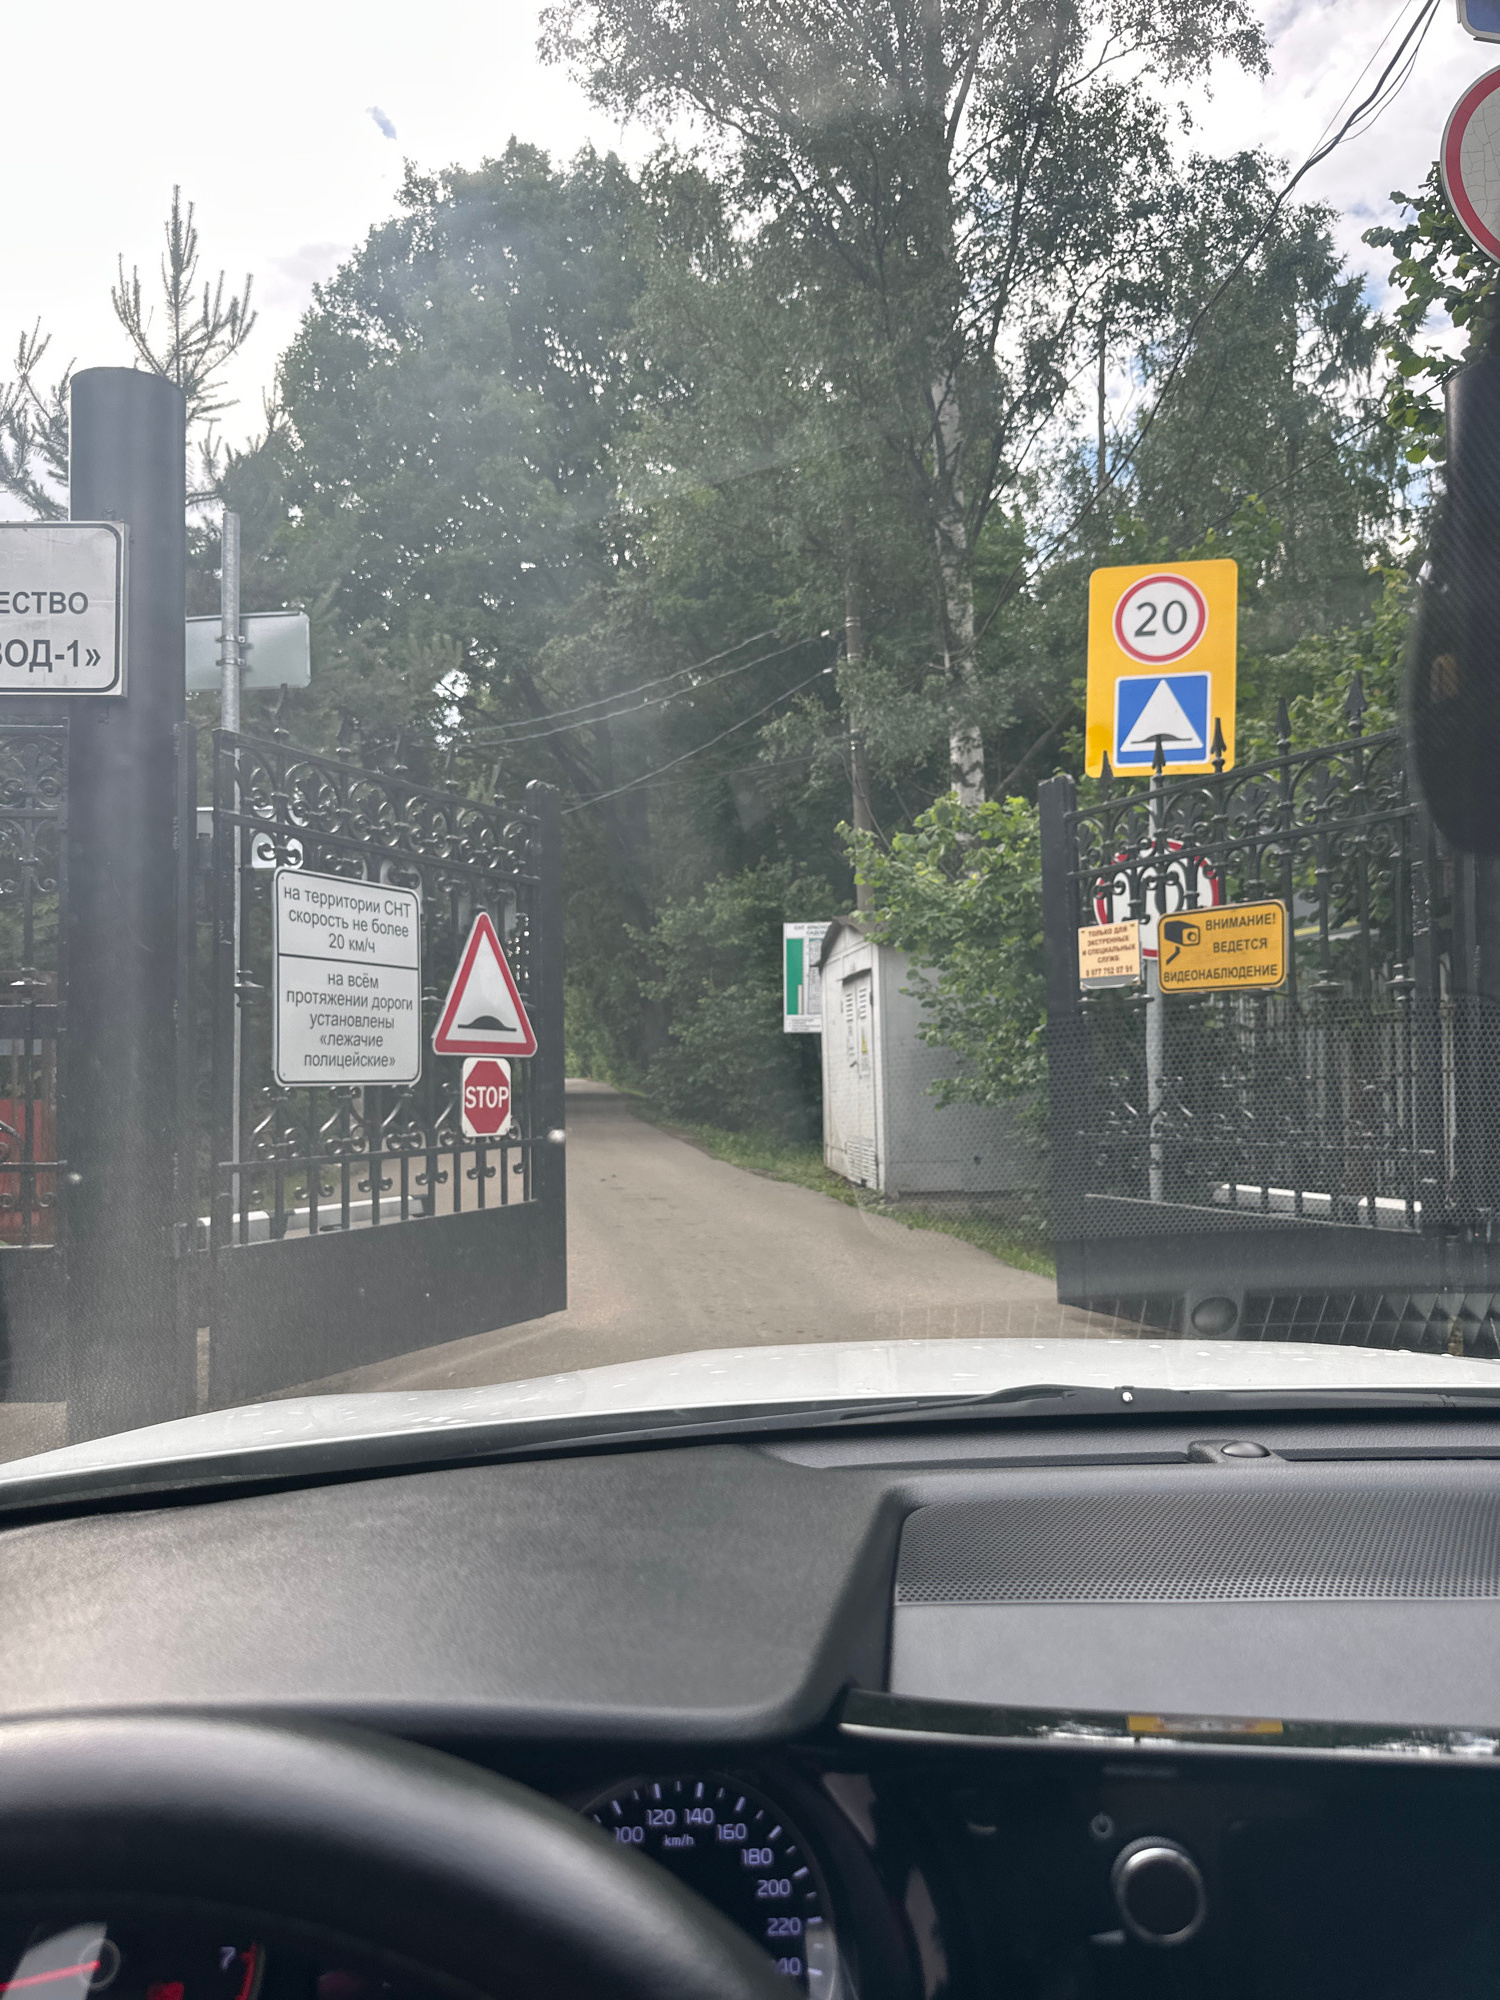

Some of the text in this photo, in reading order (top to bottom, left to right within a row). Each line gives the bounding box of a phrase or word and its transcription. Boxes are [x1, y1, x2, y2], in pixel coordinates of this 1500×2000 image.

[1133, 600, 1187, 637] 20
[0, 639, 102, 673] ОД-1»
[284, 886, 411, 918] на территории СНТ
[288, 908, 409, 938] скорость не более
[1205, 913, 1276, 931] ВНИМАНИЕ!
[328, 933, 376, 953] 20 км/ч
[1213, 937, 1268, 954] ВЕДЕТСЯ
[327, 972, 379, 989] на всём
[1163, 964, 1278, 983] ВИДЕОНАБЛЮДЕНИЕ
[286, 990, 413, 1012] протяжении дороги
[309, 1013, 395, 1030] установлены
[320, 1033, 384, 1048] «лежачие
[304, 1051, 396, 1069] полицейские»
[465, 1085, 509, 1109] STOP
[646, 1808, 676, 1826] 120
[684, 1807, 715, 1825] 140
[615, 1826, 645, 1843] 100
[664, 1834, 695, 1847] km/h
[717, 1823, 747, 1840] 160
[742, 1848, 773, 1865] 180
[757, 1879, 791, 1897] 200
[767, 1917, 801, 1935] 220
[221, 1946, 236, 1970] 7
